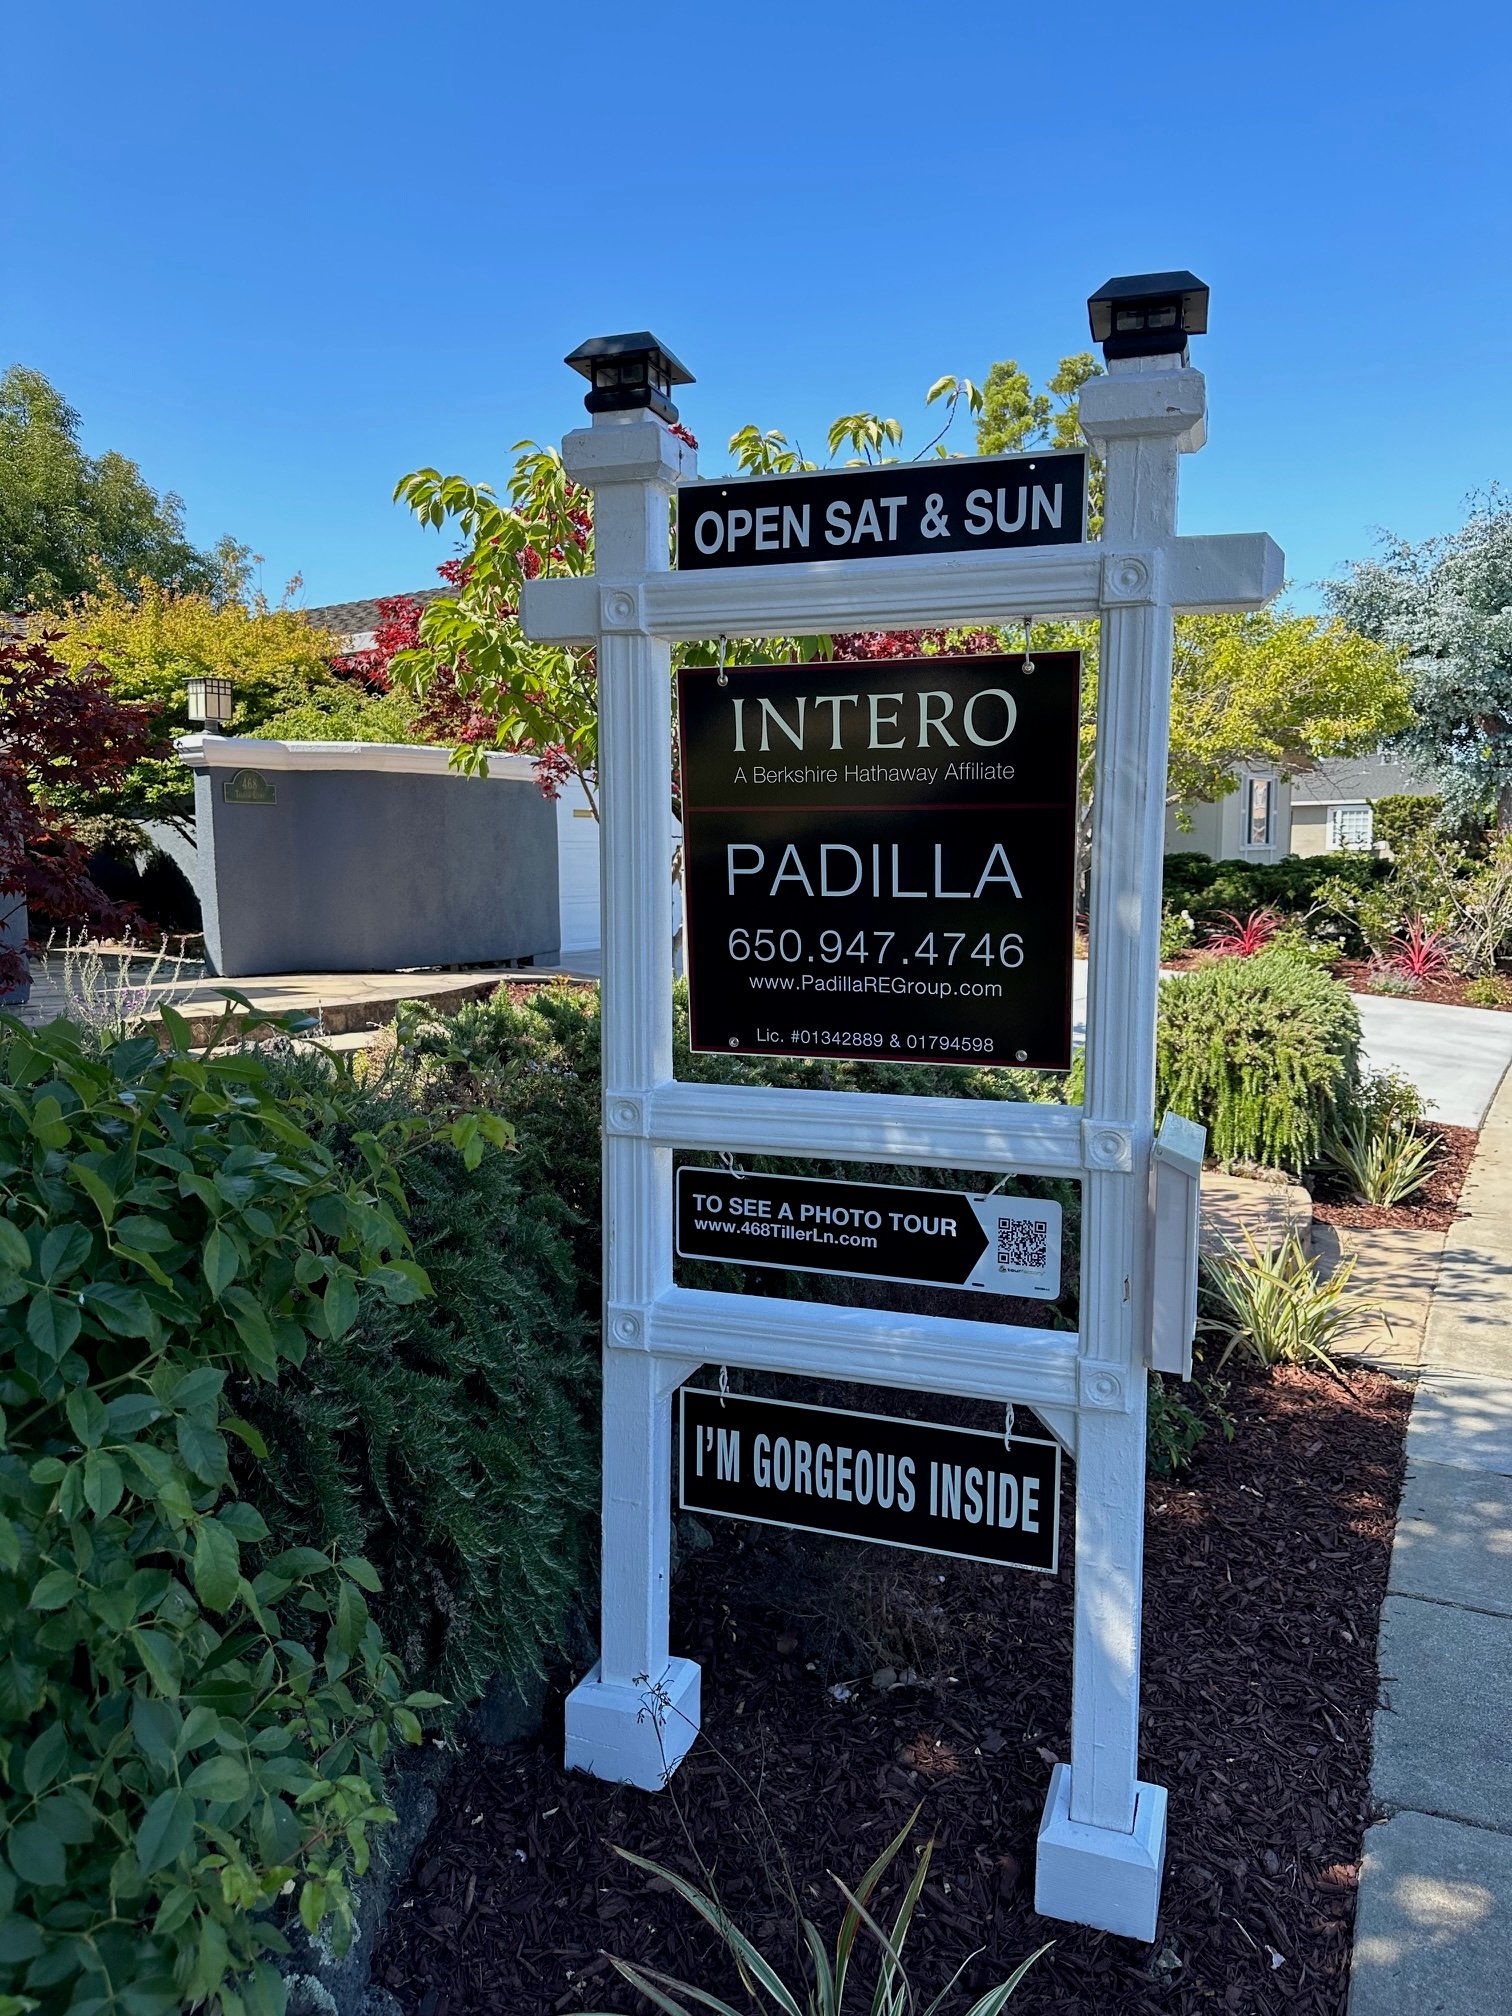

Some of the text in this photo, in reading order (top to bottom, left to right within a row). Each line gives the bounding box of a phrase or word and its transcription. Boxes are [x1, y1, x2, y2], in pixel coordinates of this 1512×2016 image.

[694, 483, 1063, 555] OPEN SAT & SUN
[731, 688, 1018, 753] INTERO
[734, 761, 1015, 785] A Berkshire Hathaway Affiliate
[727, 843, 1023, 899] PADILLA
[728, 928, 1024, 968] 650.947.4746
[749, 974, 1002, 999] www.PadillaREGroup.com
[756, 1027, 994, 1053] Lic. #01342889 & 01794598
[692, 1193, 957, 1238] TO SEE A PHOTO TOUR
[694, 1219, 878, 1248] www.468TillerLn.com
[696, 1424, 1040, 1534] I'M GORGEOUS INSIDE
